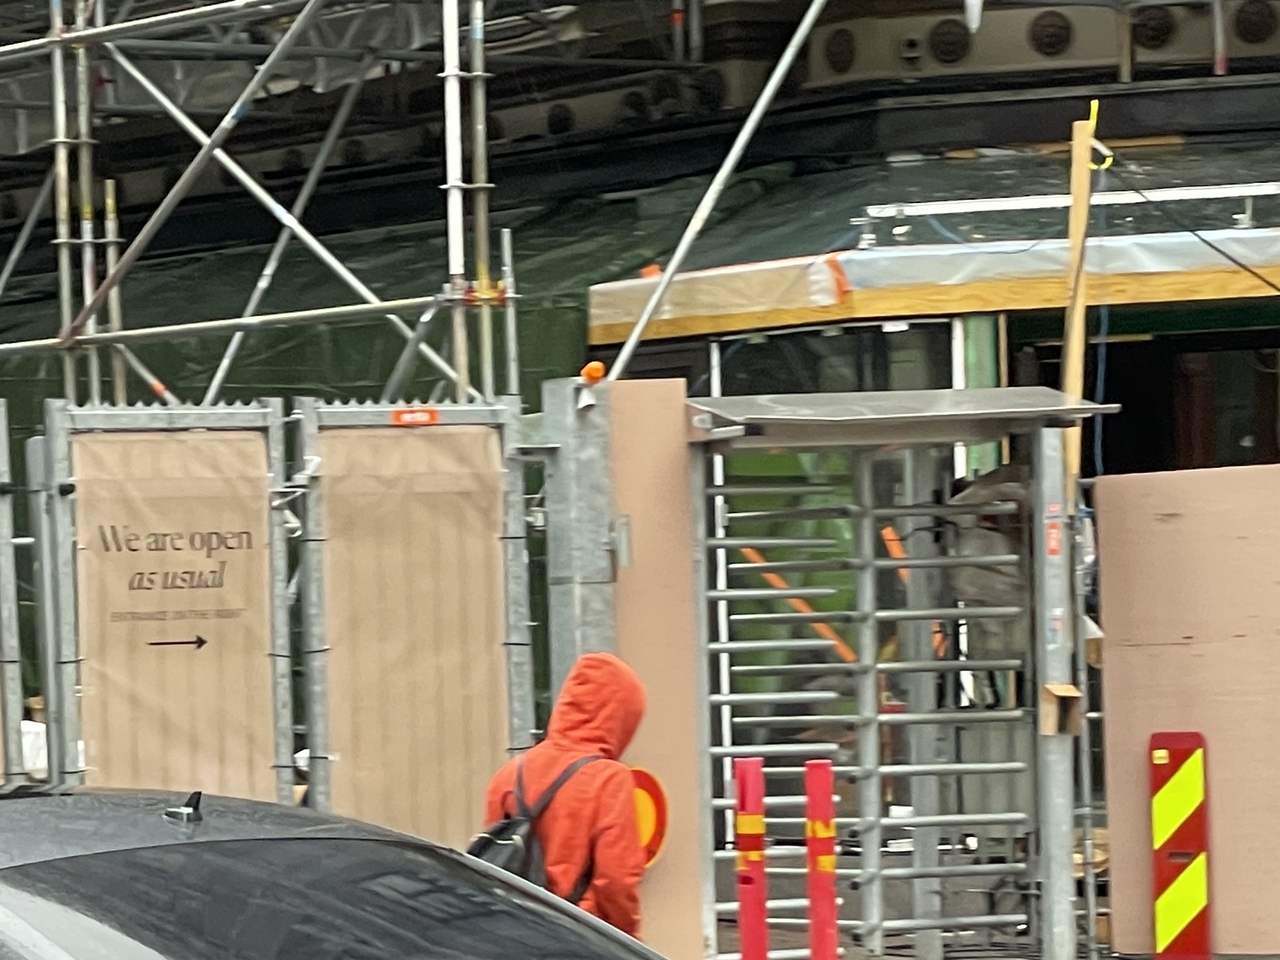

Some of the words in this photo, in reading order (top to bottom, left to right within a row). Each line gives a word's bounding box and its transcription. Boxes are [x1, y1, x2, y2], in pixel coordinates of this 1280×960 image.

[98, 524, 140, 552] We
[145, 531, 184, 552] are
[188, 530, 254, 559] open
[128, 570, 159, 590] as
[161, 560, 228, 590] usual
